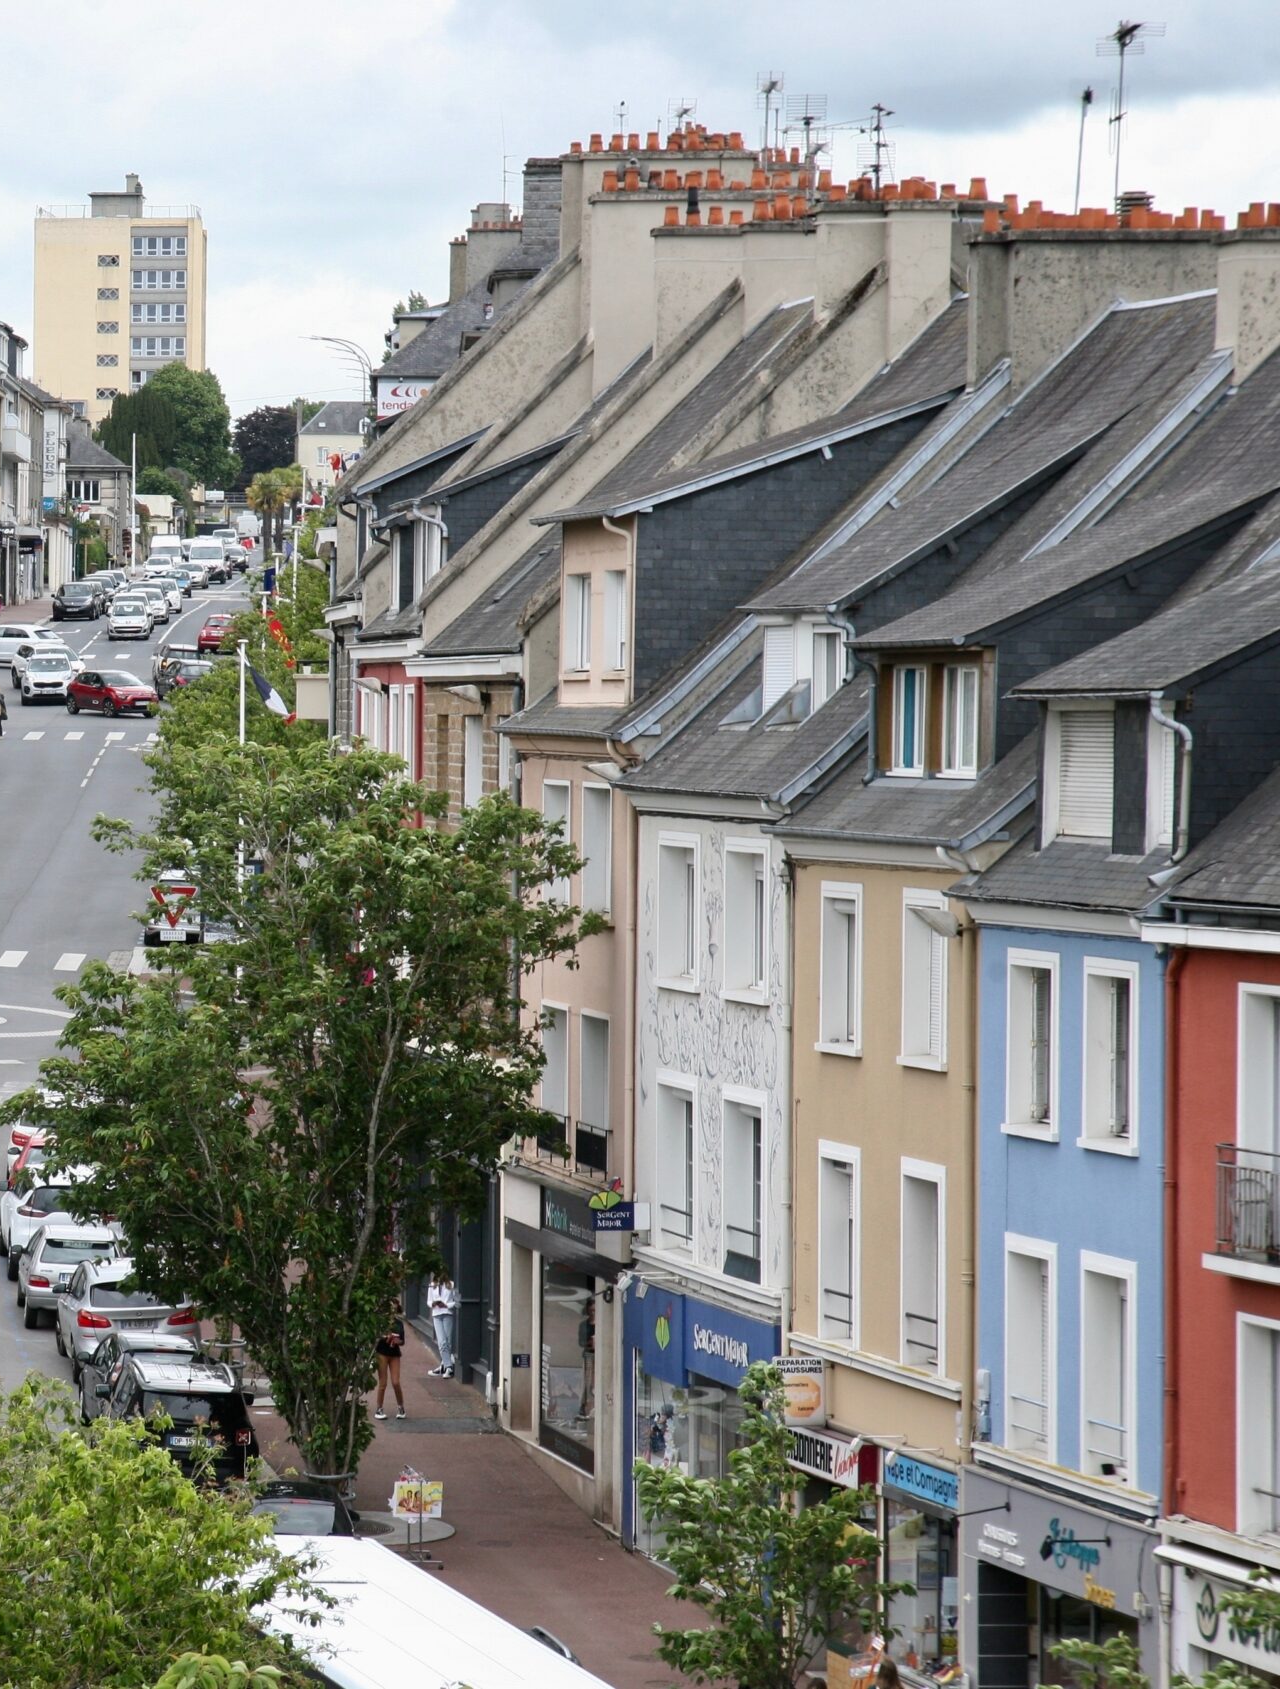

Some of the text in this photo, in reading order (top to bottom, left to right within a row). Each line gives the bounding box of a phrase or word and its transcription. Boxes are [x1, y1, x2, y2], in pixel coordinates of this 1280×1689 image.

[382, 401, 415, 410] tenda
[45, 431, 56, 477] FLEURS
[776, 1359, 822, 1367] REPARATION
[777, 1366, 823, 1374] CHAUSSURES
[906, 1465, 915, 1485] et
[915, 1465, 959, 1503] Compagnie
